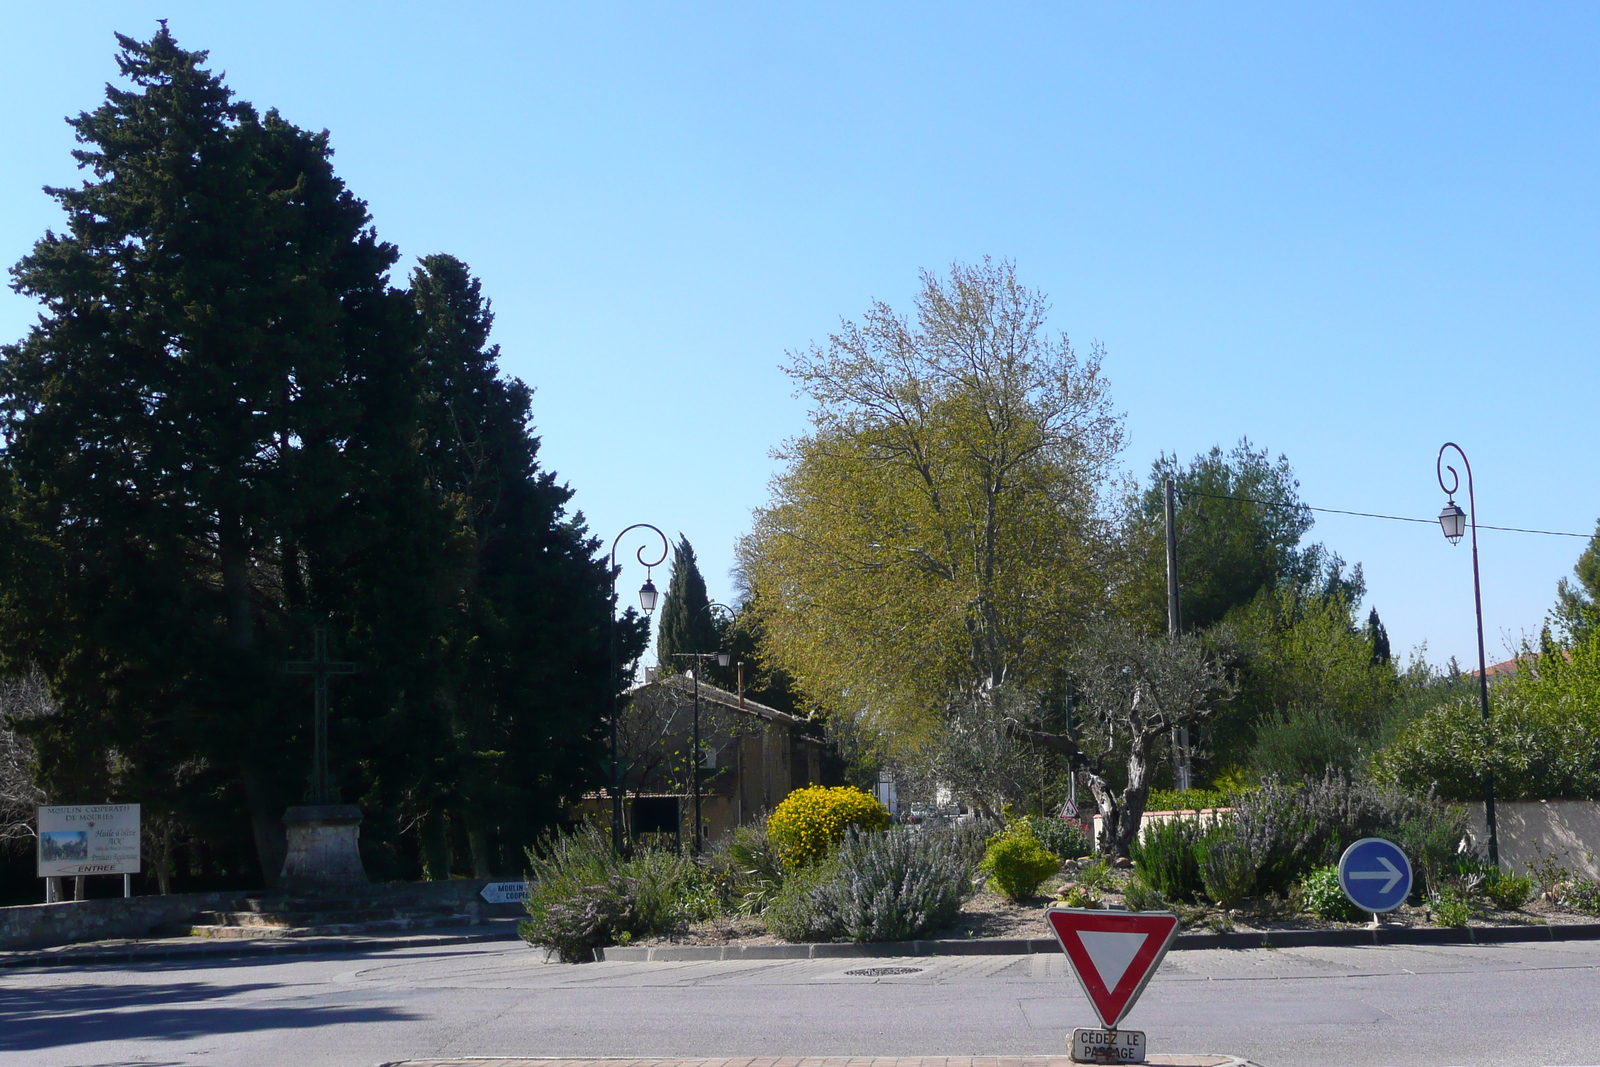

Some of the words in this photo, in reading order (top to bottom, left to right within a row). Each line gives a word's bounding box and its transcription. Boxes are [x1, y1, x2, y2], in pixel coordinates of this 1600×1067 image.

[95, 829, 114, 838] Huile
[1081, 1031, 1117, 1045] CÉDEZ
[1127, 1035, 1139, 1046] LE
